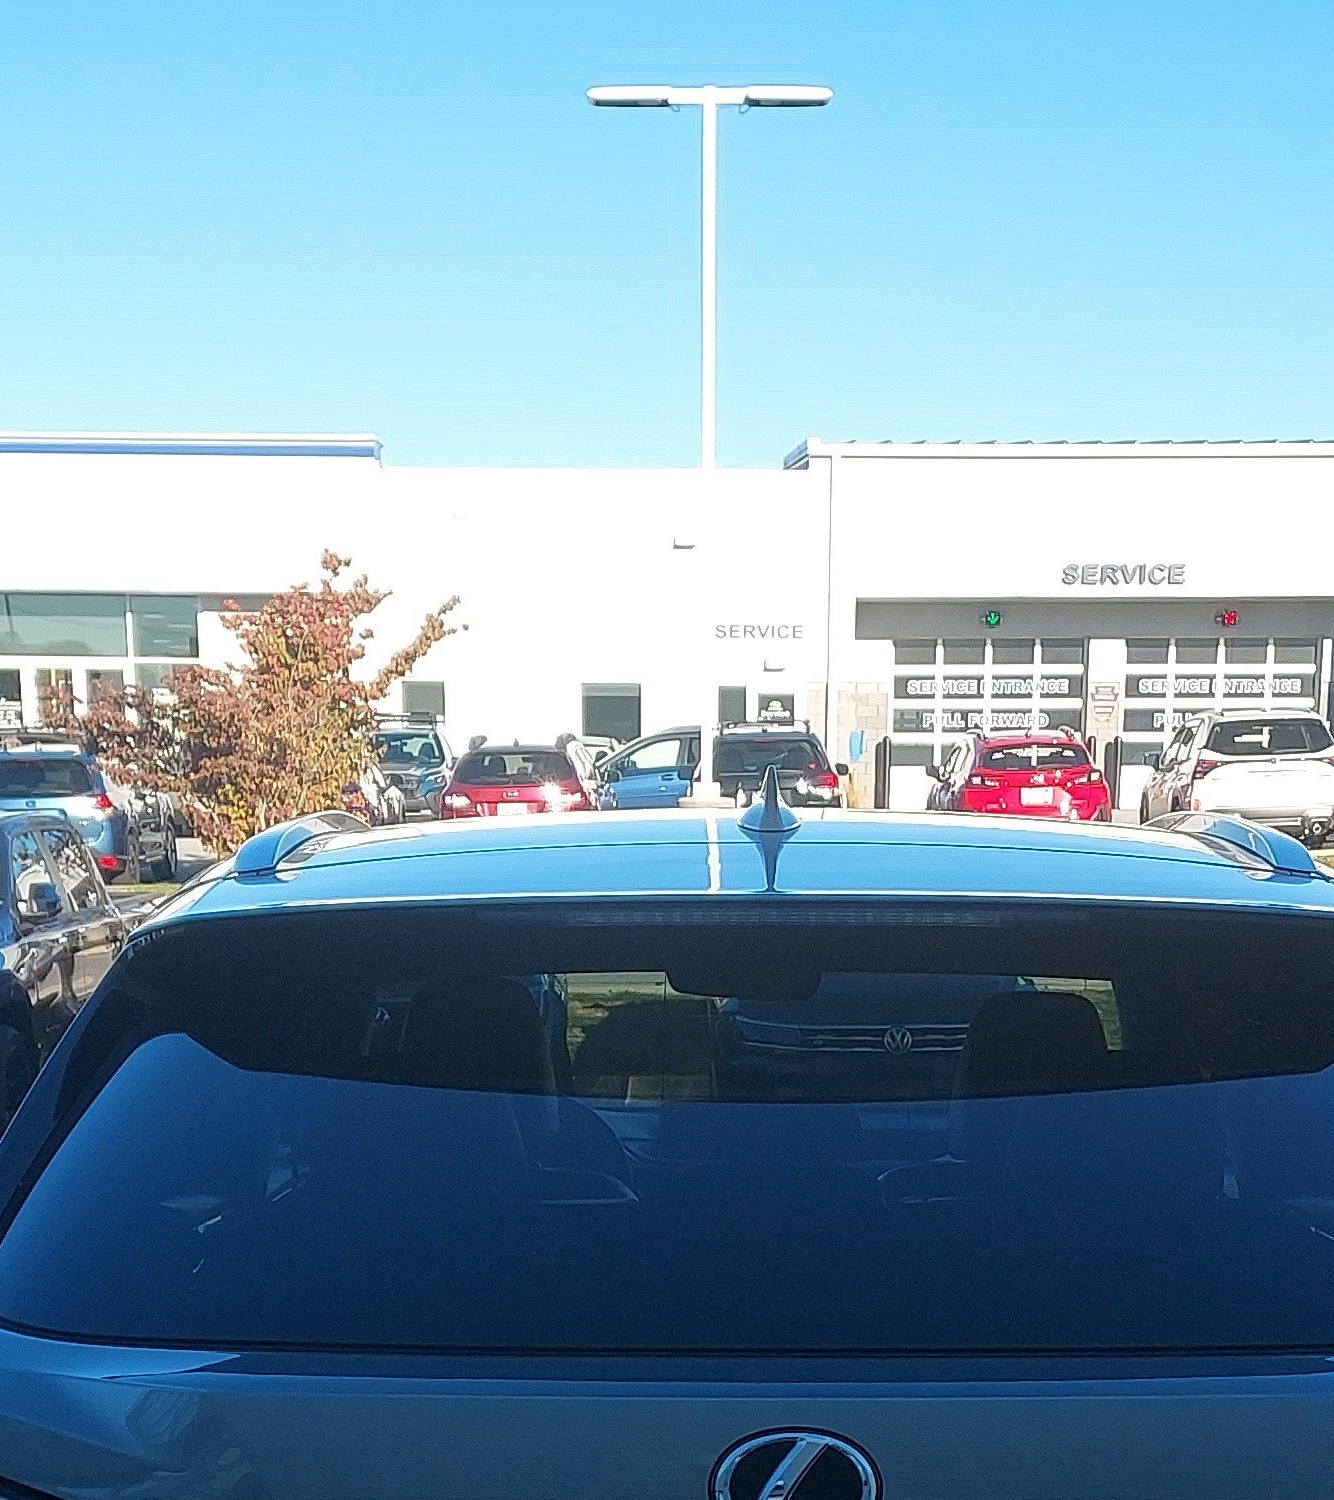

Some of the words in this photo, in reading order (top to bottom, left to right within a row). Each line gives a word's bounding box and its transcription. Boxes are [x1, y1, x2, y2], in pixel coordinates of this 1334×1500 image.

[1062, 563, 1186, 585] SERVICE
[715, 624, 803, 639] SERVICE
[908, 680, 977, 693] SERVICE
[1140, 679, 1208, 692] SERVICE
[924, 714, 964, 727] PULL
[969, 713, 1048, 727] FORWARD
